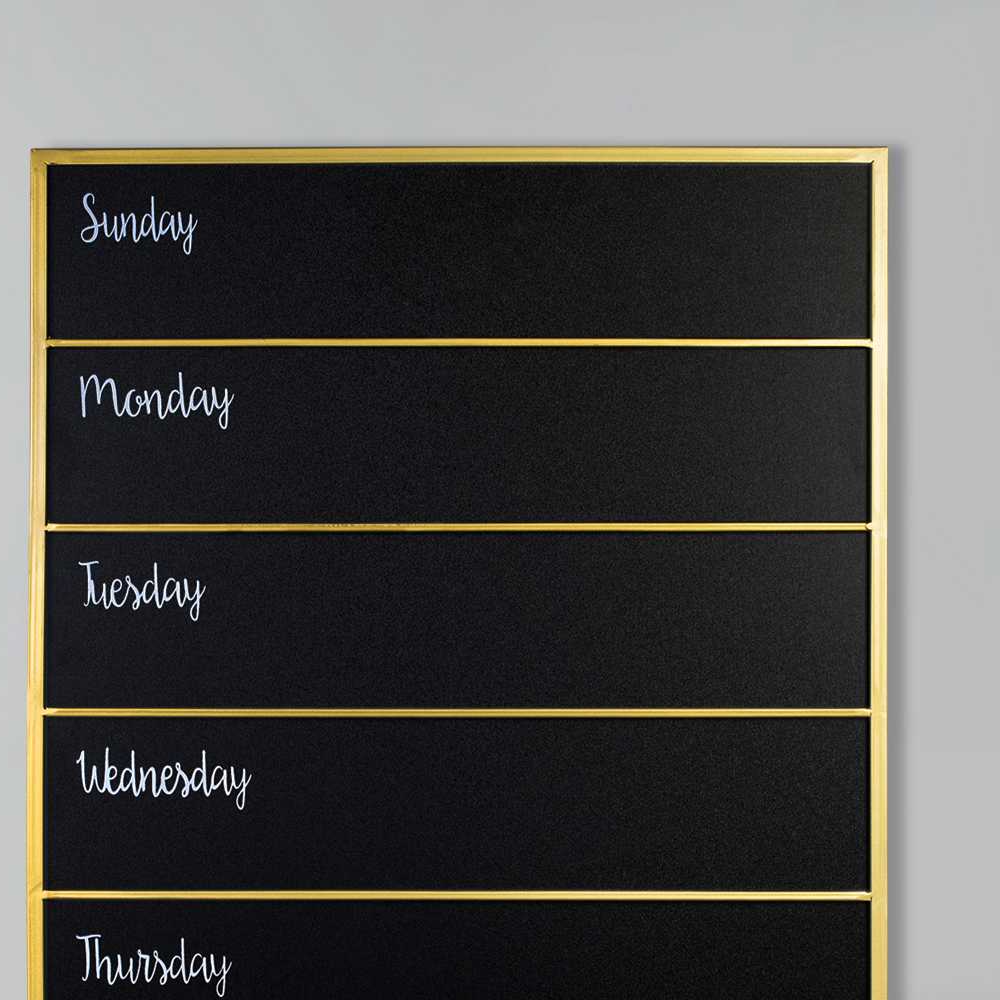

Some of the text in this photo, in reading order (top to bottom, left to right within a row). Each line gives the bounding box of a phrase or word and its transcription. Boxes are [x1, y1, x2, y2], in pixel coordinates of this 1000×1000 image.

[80, 192, 198, 255] Sunday
[79, 371, 235, 430] Monday
[78, 560, 207, 622] Tuesday
[75, 746, 253, 811] Wednesday
[75, 934, 233, 998] Thursday
